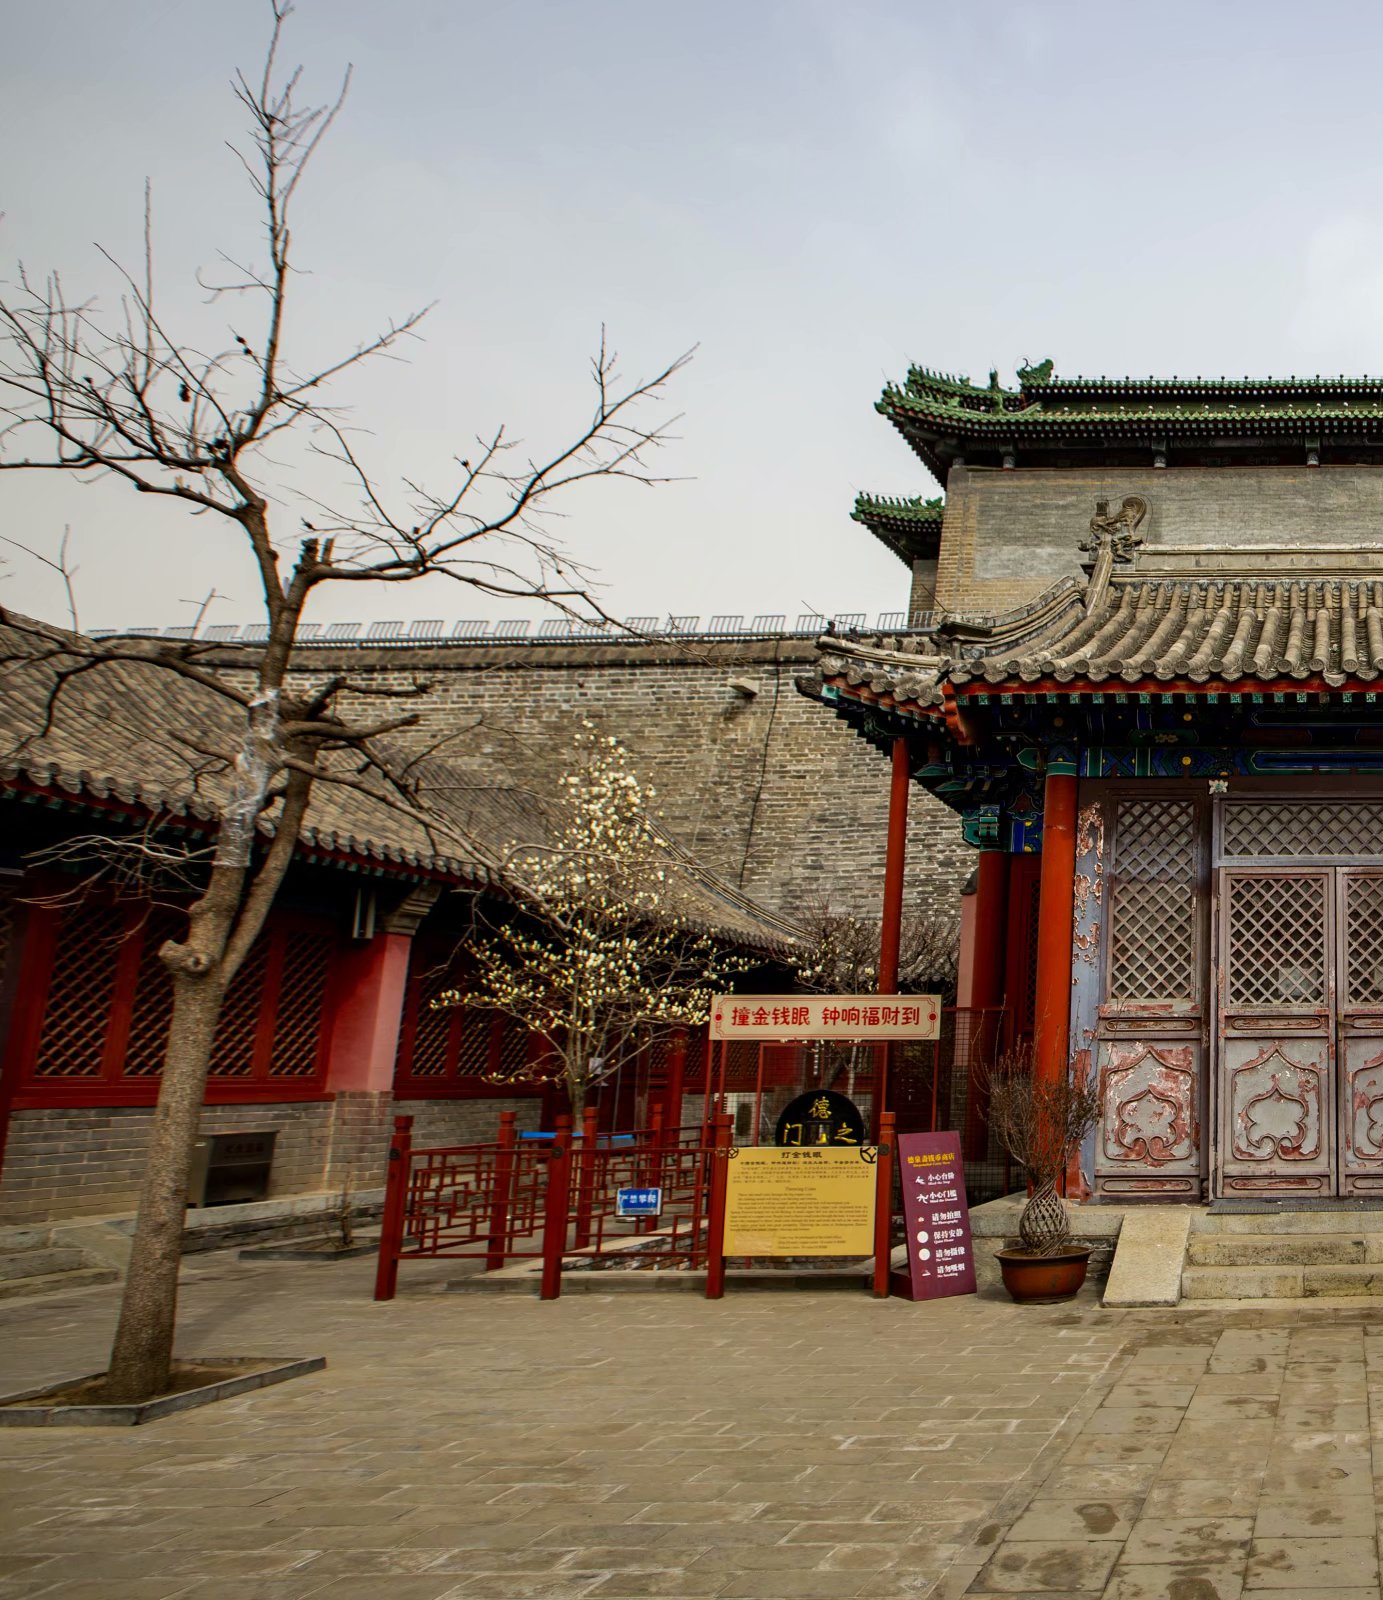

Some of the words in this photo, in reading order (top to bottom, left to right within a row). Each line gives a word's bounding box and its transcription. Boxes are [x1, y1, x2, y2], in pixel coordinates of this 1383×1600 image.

[731, 1006, 810, 1026] 撞金钱眼
[821, 1006, 920, 1026] 钟响福财到
[808, 1096, 832, 1119] 德
[783, 1122, 803, 1146] 门
[834, 1122, 858, 1145] 之
[780, 1151, 823, 1159] 打金钱眼
[928, 1172, 954, 1182] 小心台阶
[930, 1190, 957, 1200] 小心门槛
[932, 1211, 961, 1221] 请勿拍照
[934, 1228, 963, 1239] 保持安静
[936, 1246, 965, 1258] 请勿摄像
[937, 1263, 965, 1274] 请勿吸烟
